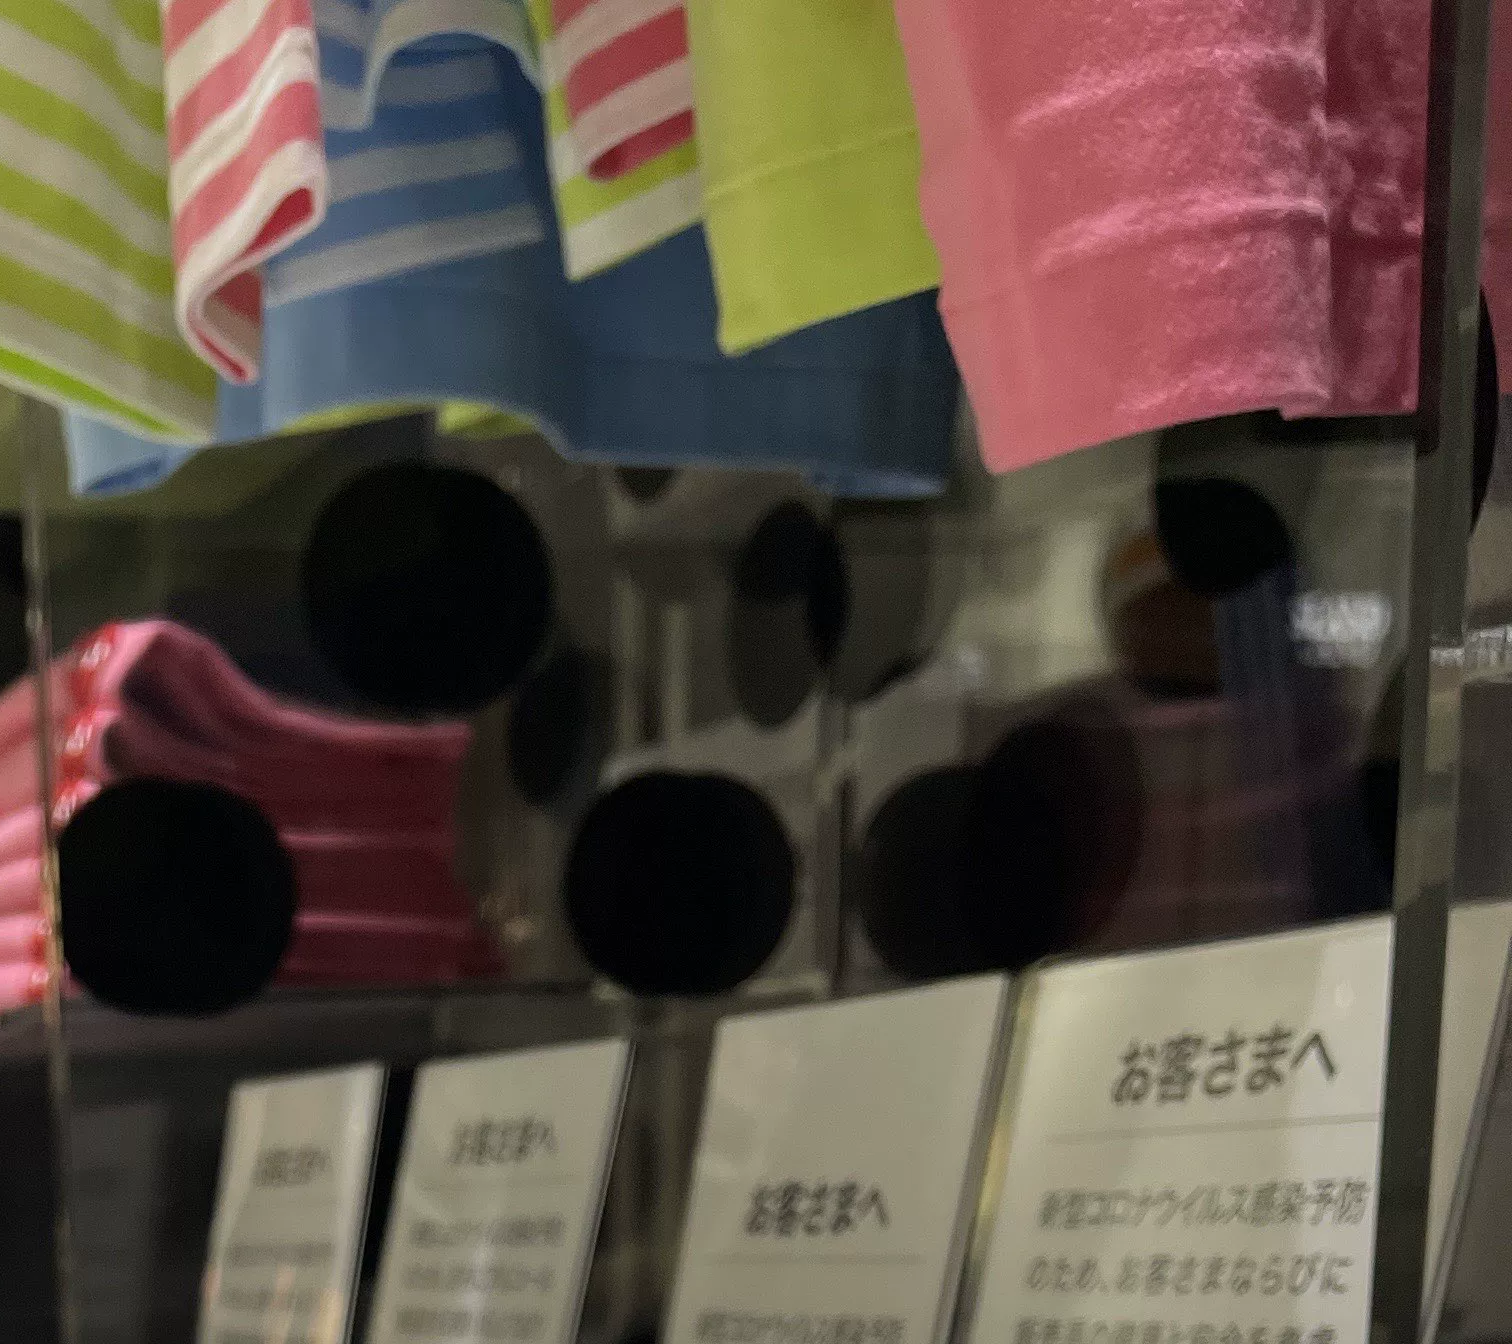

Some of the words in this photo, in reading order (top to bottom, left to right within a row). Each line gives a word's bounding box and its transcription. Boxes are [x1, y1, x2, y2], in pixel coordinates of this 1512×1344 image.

[1110, 1022, 1337, 1104] お客さまへ
